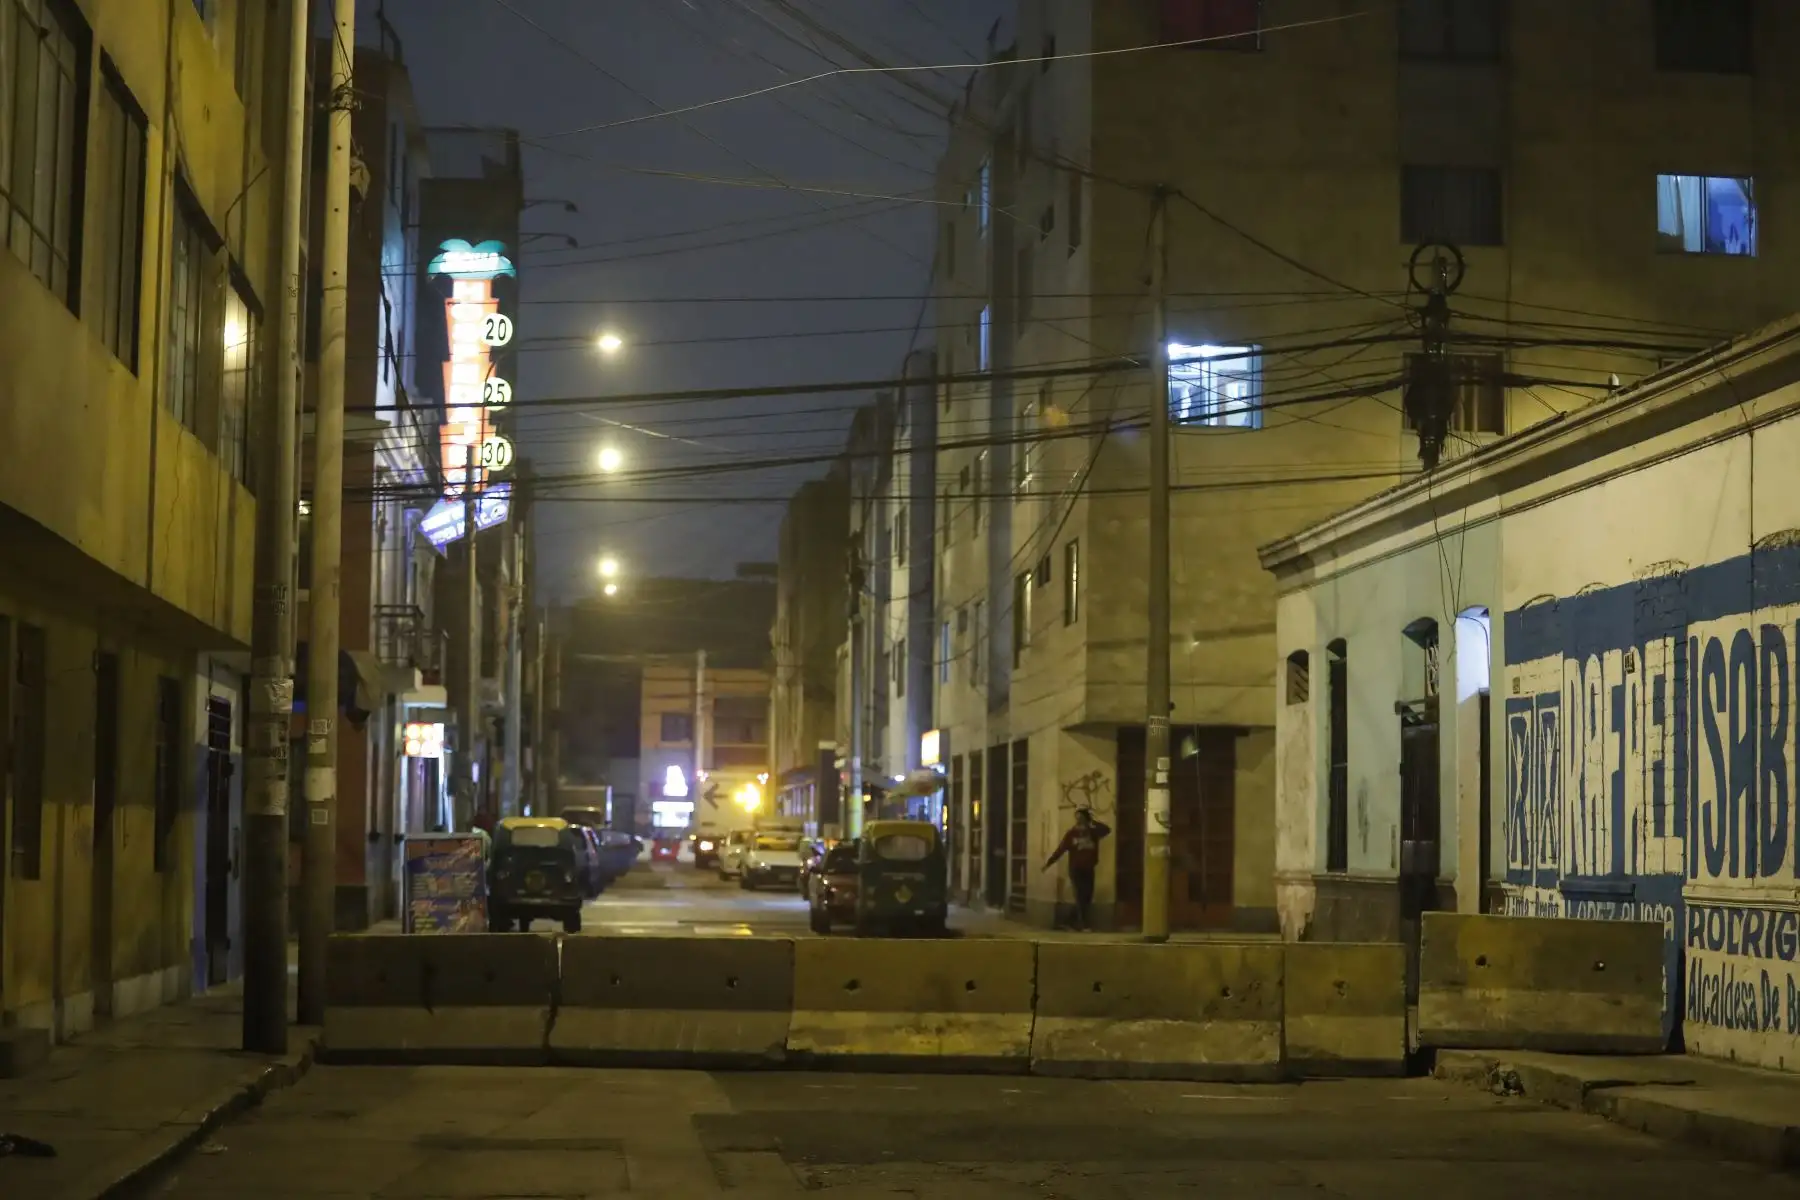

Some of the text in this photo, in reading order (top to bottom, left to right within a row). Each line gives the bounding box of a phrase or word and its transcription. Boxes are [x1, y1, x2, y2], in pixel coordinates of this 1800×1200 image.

[486, 318, 507, 341] 20
[484, 383, 505, 402] 25
[484, 442, 505, 464] 30
[1563, 637, 1684, 876] RAFAEL
[1689, 618, 1800, 880] ISAB
[1688, 904, 1800, 962] RODRIG
[1688, 957, 1759, 1033] Alcaldesa
[1760, 968, 1781, 1033] De
